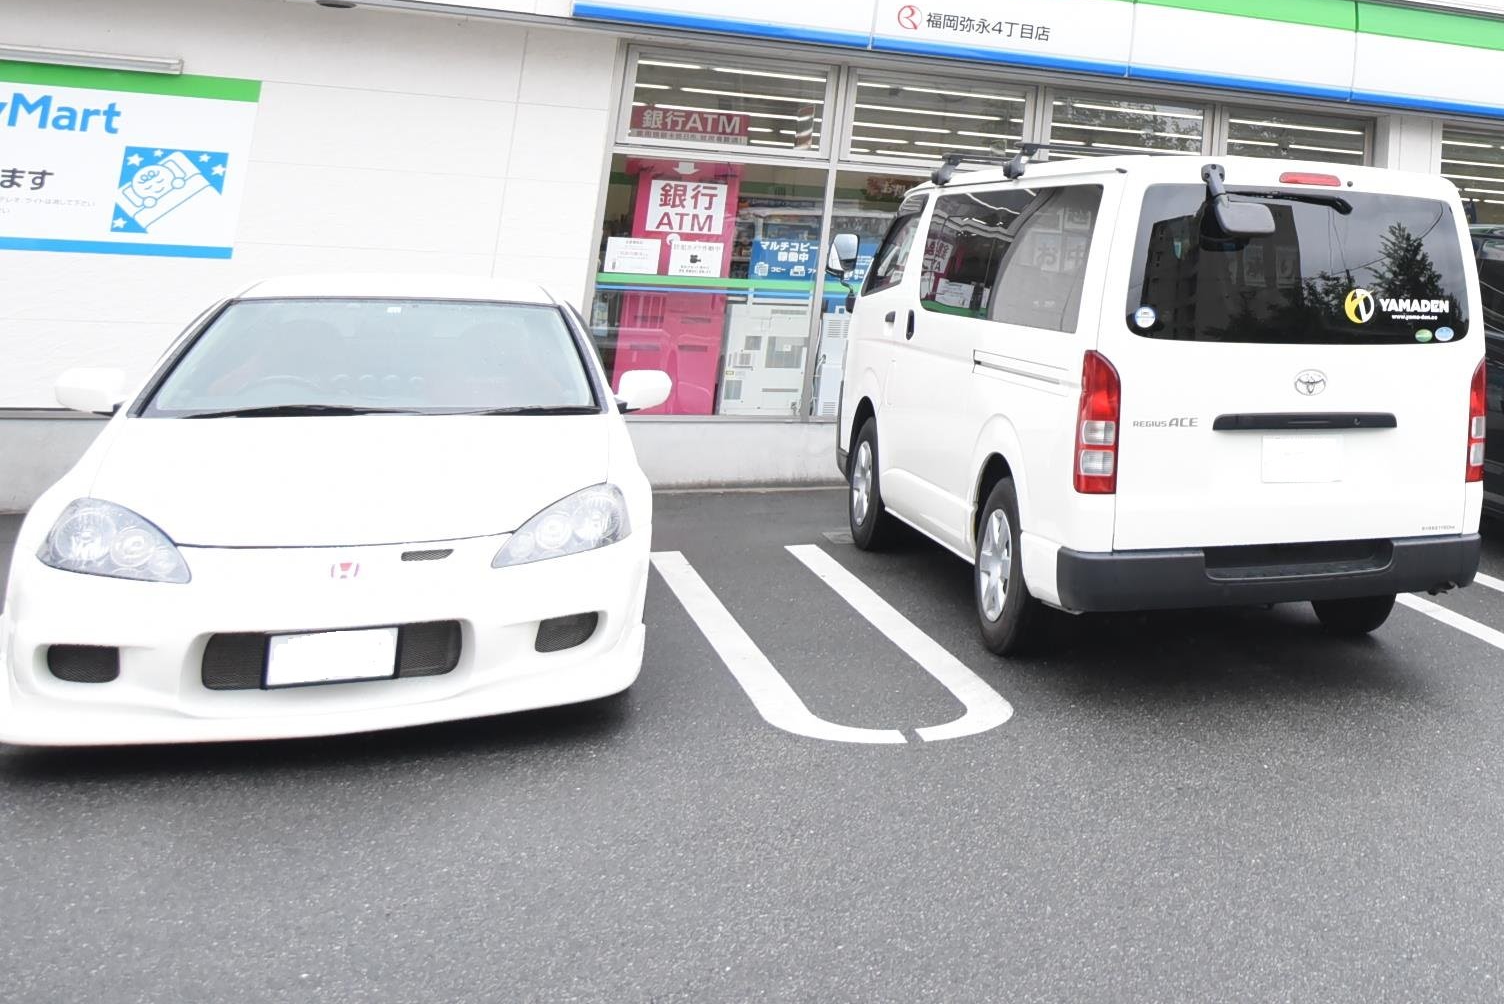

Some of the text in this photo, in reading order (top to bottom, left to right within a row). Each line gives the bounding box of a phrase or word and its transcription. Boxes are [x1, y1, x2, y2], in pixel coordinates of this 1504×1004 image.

[926, 12, 1051, 41] 福岡弥永4丁目店
[642, 109, 741, 134] 銀行ATM
[0, 168, 55, 191] ます
[659, 182, 718, 210] 銀行
[655, 211, 714, 232] ATM
[760, 241, 819, 252] マルチコピー
[1380, 298, 1449, 313] YAMADEN
[1132, 417, 1199, 428] REGIUS ACE
